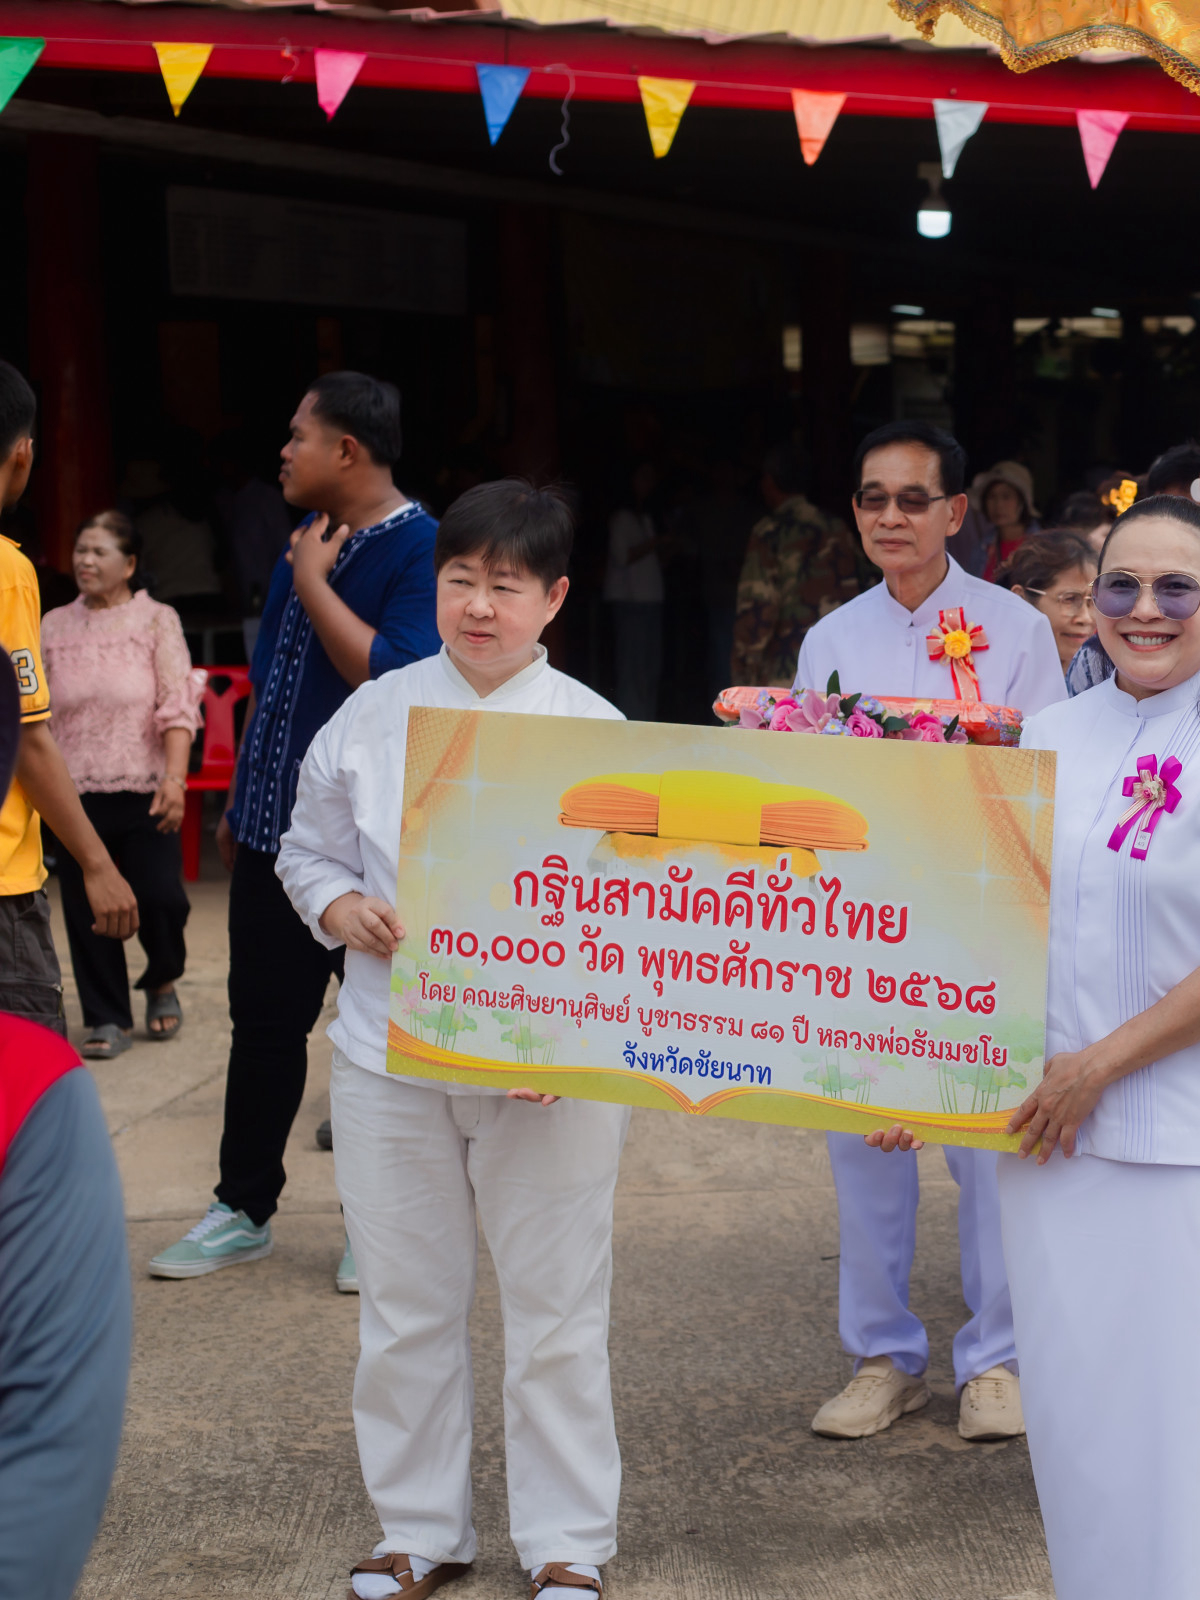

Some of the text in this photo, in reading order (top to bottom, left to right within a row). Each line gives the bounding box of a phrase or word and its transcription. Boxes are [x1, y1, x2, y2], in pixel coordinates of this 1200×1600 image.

[513, 854, 908, 944] กฐินสามัคคีทั่วไทย
[430, 924, 996, 1015] ๓๐,๐๐๐ วัด พุทธศักราช ๒๕๖๘
[419, 972, 1008, 1067] โดย คณะศิษยานุศิษย์ บูชาธรรม ๘๑ ปี หลวงพ่อธัมมชโย
[622, 1040, 772, 1085] จังหวัดชัยนาท
